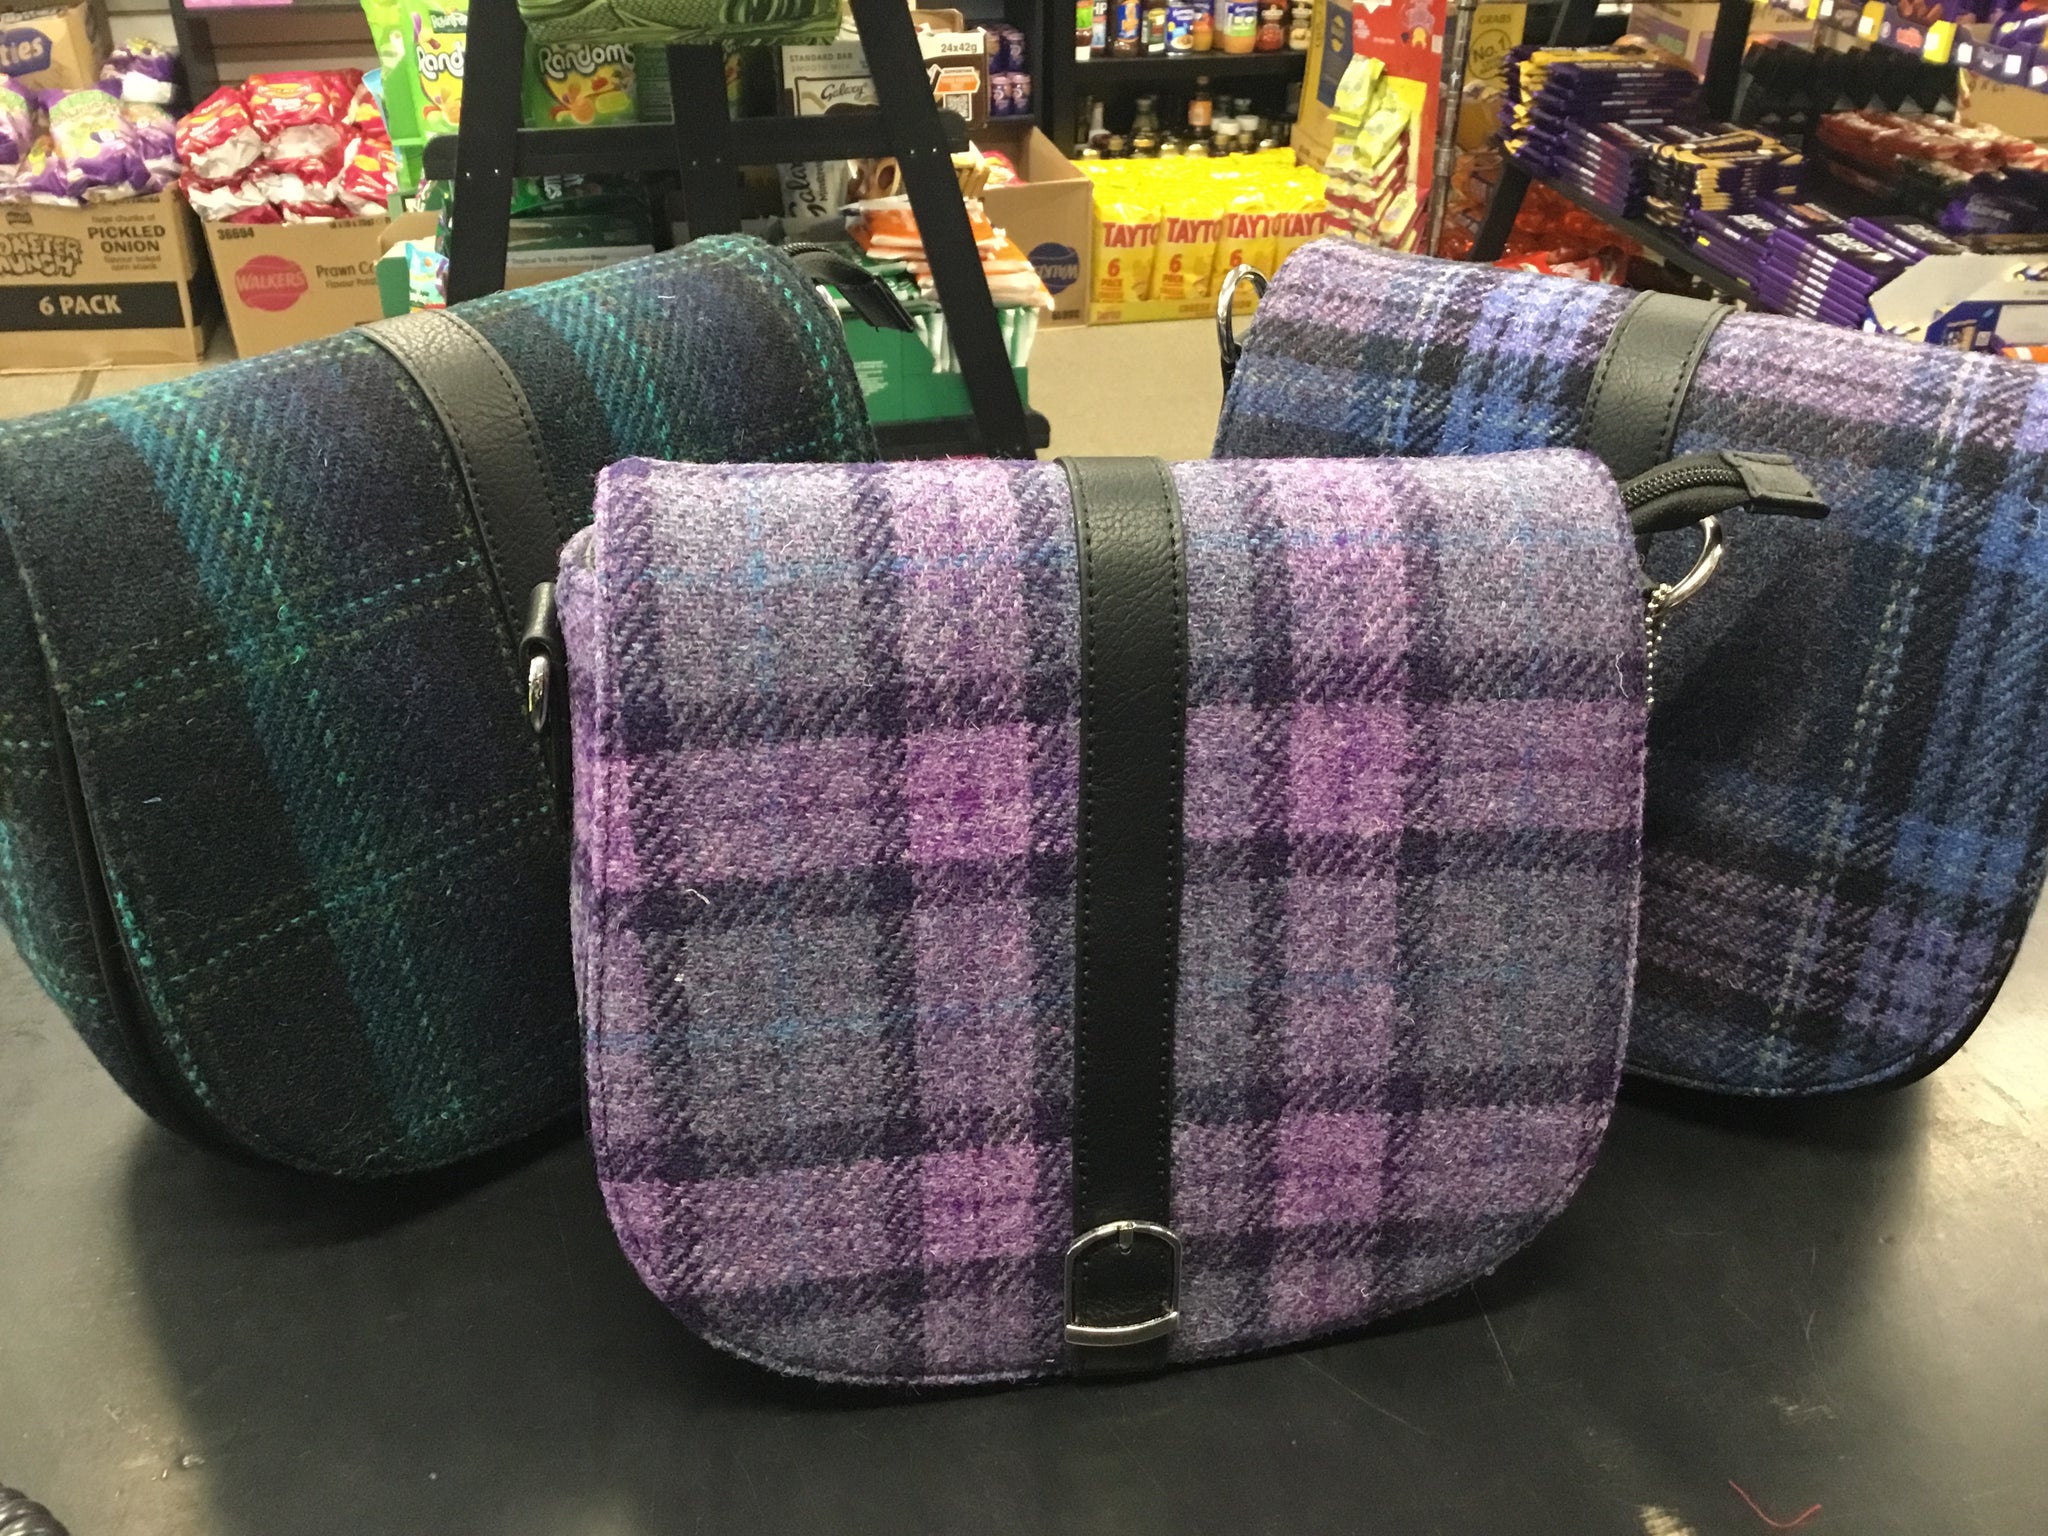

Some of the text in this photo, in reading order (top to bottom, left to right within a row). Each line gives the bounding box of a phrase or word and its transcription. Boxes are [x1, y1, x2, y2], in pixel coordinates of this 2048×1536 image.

[790, 52, 853, 62] STANDARD BAR
[941, 43, 977, 54] 24x42g
[540, 43, 635, 79] Randoms
[821, 83, 864, 102] Galaxy
[88, 225, 166, 239] PICKLED
[1167, 217, 1222, 243] TAYTO
[1225, 212, 1280, 238] TAYTO
[101, 240, 160, 253] ONION
[316, 265, 356, 278] Prawn
[1108, 258, 1120, 277] 6
[1169, 253, 1182, 273] 6
[236, 271, 305, 291] WALKERS
[39, 295, 122, 316] 6 PACK
